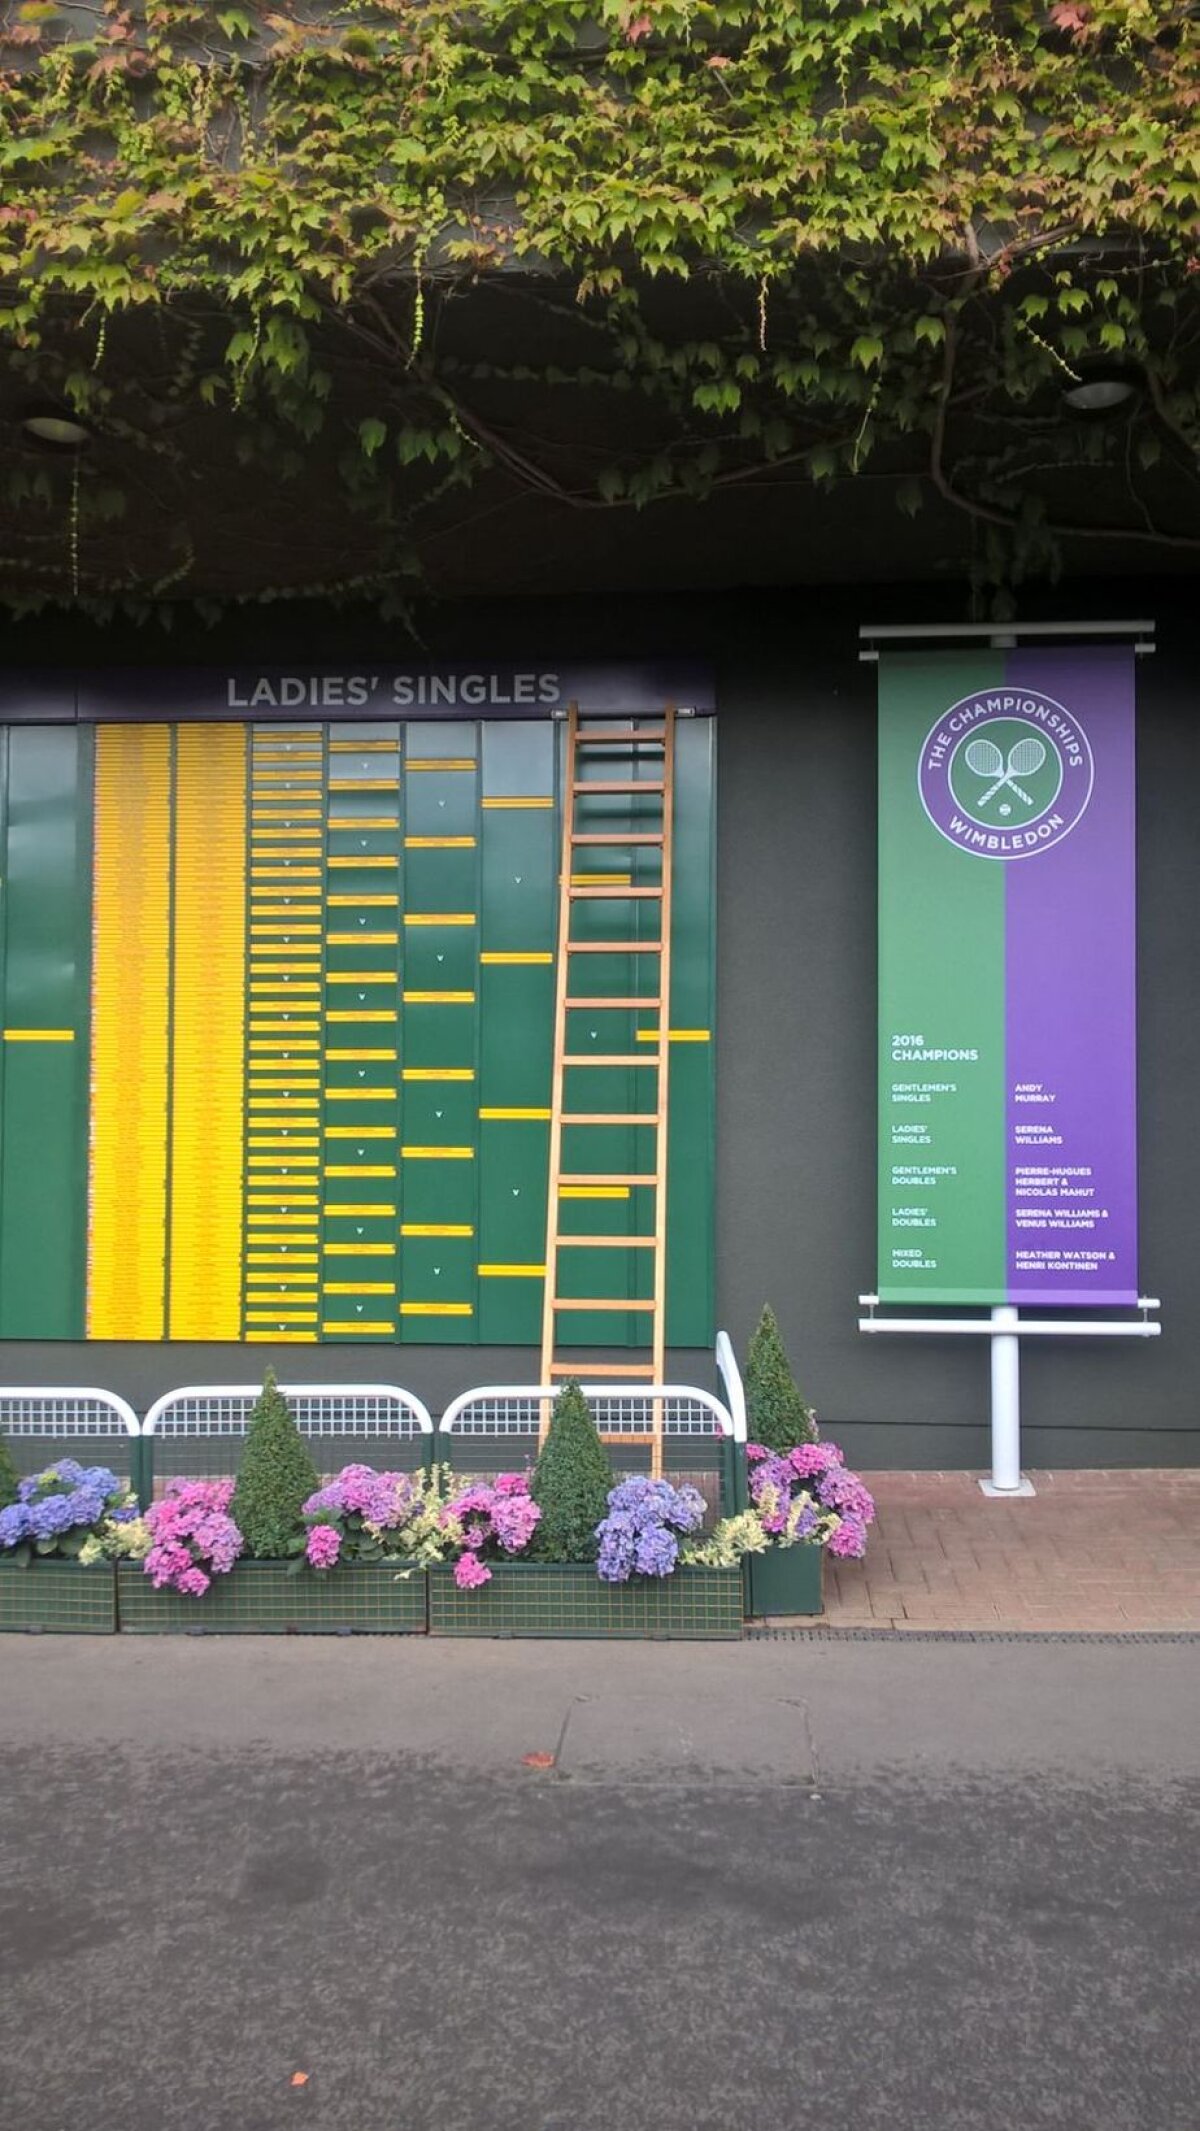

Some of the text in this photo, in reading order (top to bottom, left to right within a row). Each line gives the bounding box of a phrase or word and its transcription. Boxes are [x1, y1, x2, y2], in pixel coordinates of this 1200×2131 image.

[228, 674, 561, 706] LADIES' SINGLES
[928, 697, 1083, 770] THE CHAMPIONSHIPS
[949, 813, 1064, 850] WIMBLEDON
[892, 1035, 924, 1046] 2016
[892, 1049, 978, 1061] CHAMPIONS
[1015, 1083, 1043, 1092] ANDY
[892, 1093, 931, 1102] SINGLES
[1015, 1094, 1056, 1103] MURRAY
[1015, 1125, 1053, 1134] SERENA
[892, 1135, 931, 1144] SINGLES
[1015, 1136, 1063, 1145] WILLIAMS
[892, 1176, 936, 1185] DOUBLES
[1016, 1177, 1060, 1186] HERBERT
[1015, 1188, 1095, 1197] NICOLAS MAHUT
[1015, 1209, 1053, 1218] SERENA
[1053, 1209, 1101, 1218] WILLIAMS
[892, 1218, 936, 1227] DOUBLES
[1015, 1219, 1095, 1228] VENUS WILLIAMS
[892, 1249, 923, 1258] MIXED
[1016, 1250, 1061, 1259] HEATHER
[1062, 1251, 1107, 1260] WATSON
[892, 1259, 937, 1268] DOUBLES
[1016, 1261, 1098, 1270] HENRI KONTINEN
